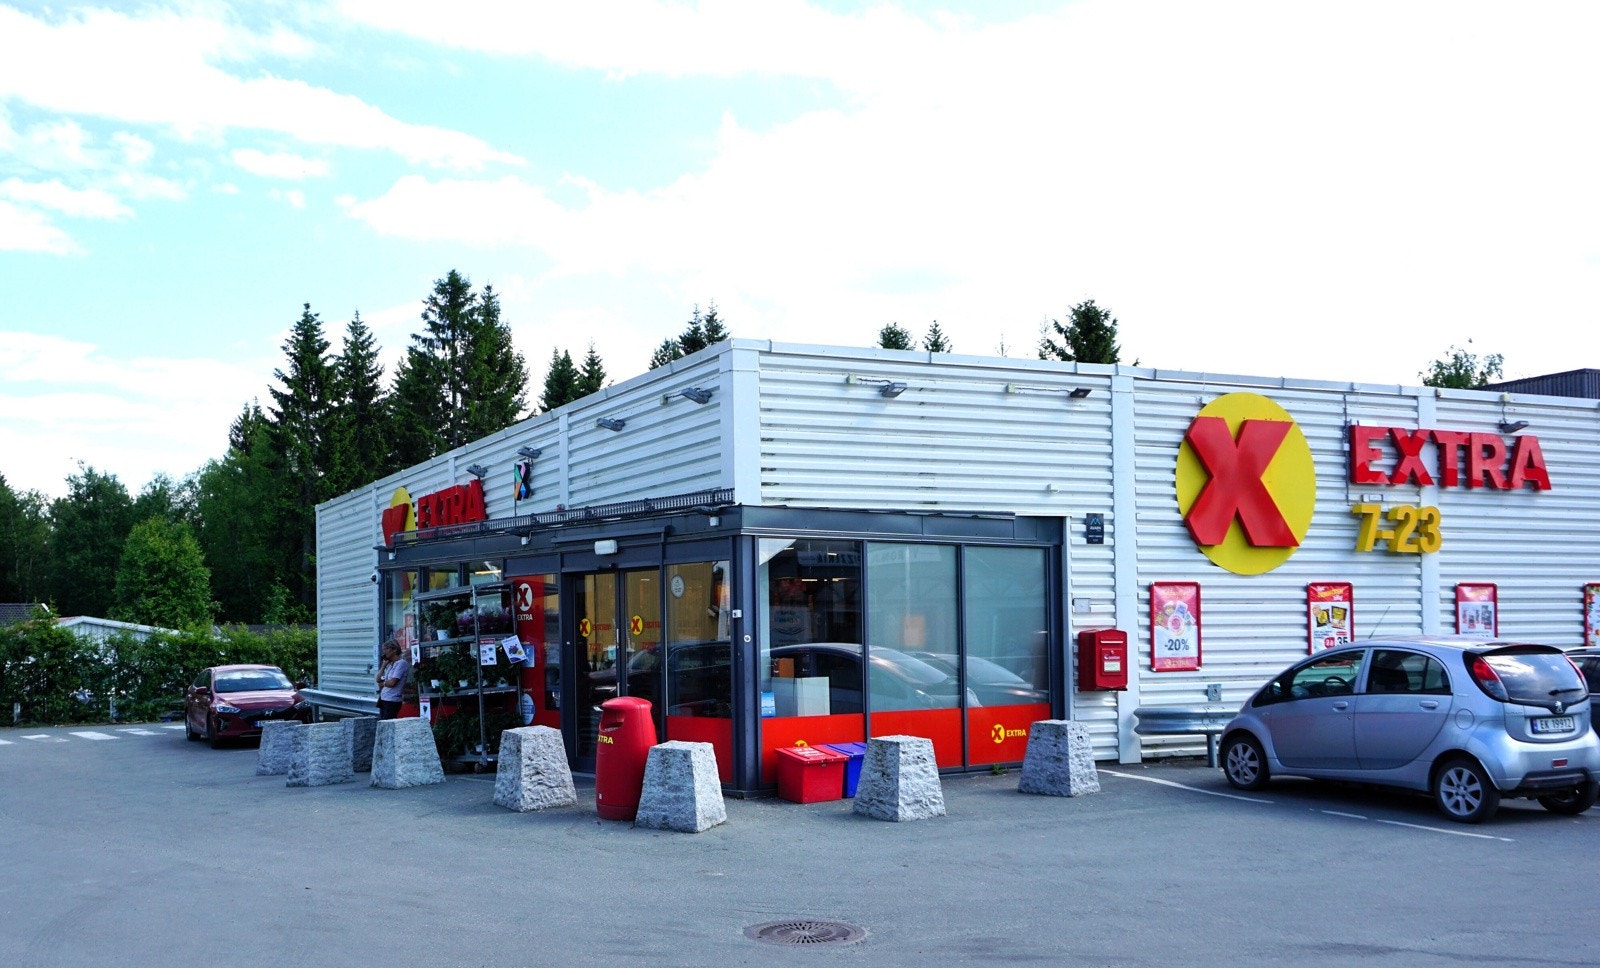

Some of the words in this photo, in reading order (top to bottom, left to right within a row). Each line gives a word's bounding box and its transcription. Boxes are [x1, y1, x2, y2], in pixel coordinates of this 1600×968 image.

[1184, 416, 1300, 547] X
[1350, 425, 1552, 491] EXTRA
[418, 479, 486, 536] EXTRA
[1353, 504, 1443, 554] 7-23
[1164, 639, 1190, 651] -20%
[1006, 729, 1027, 737] EXTRA
